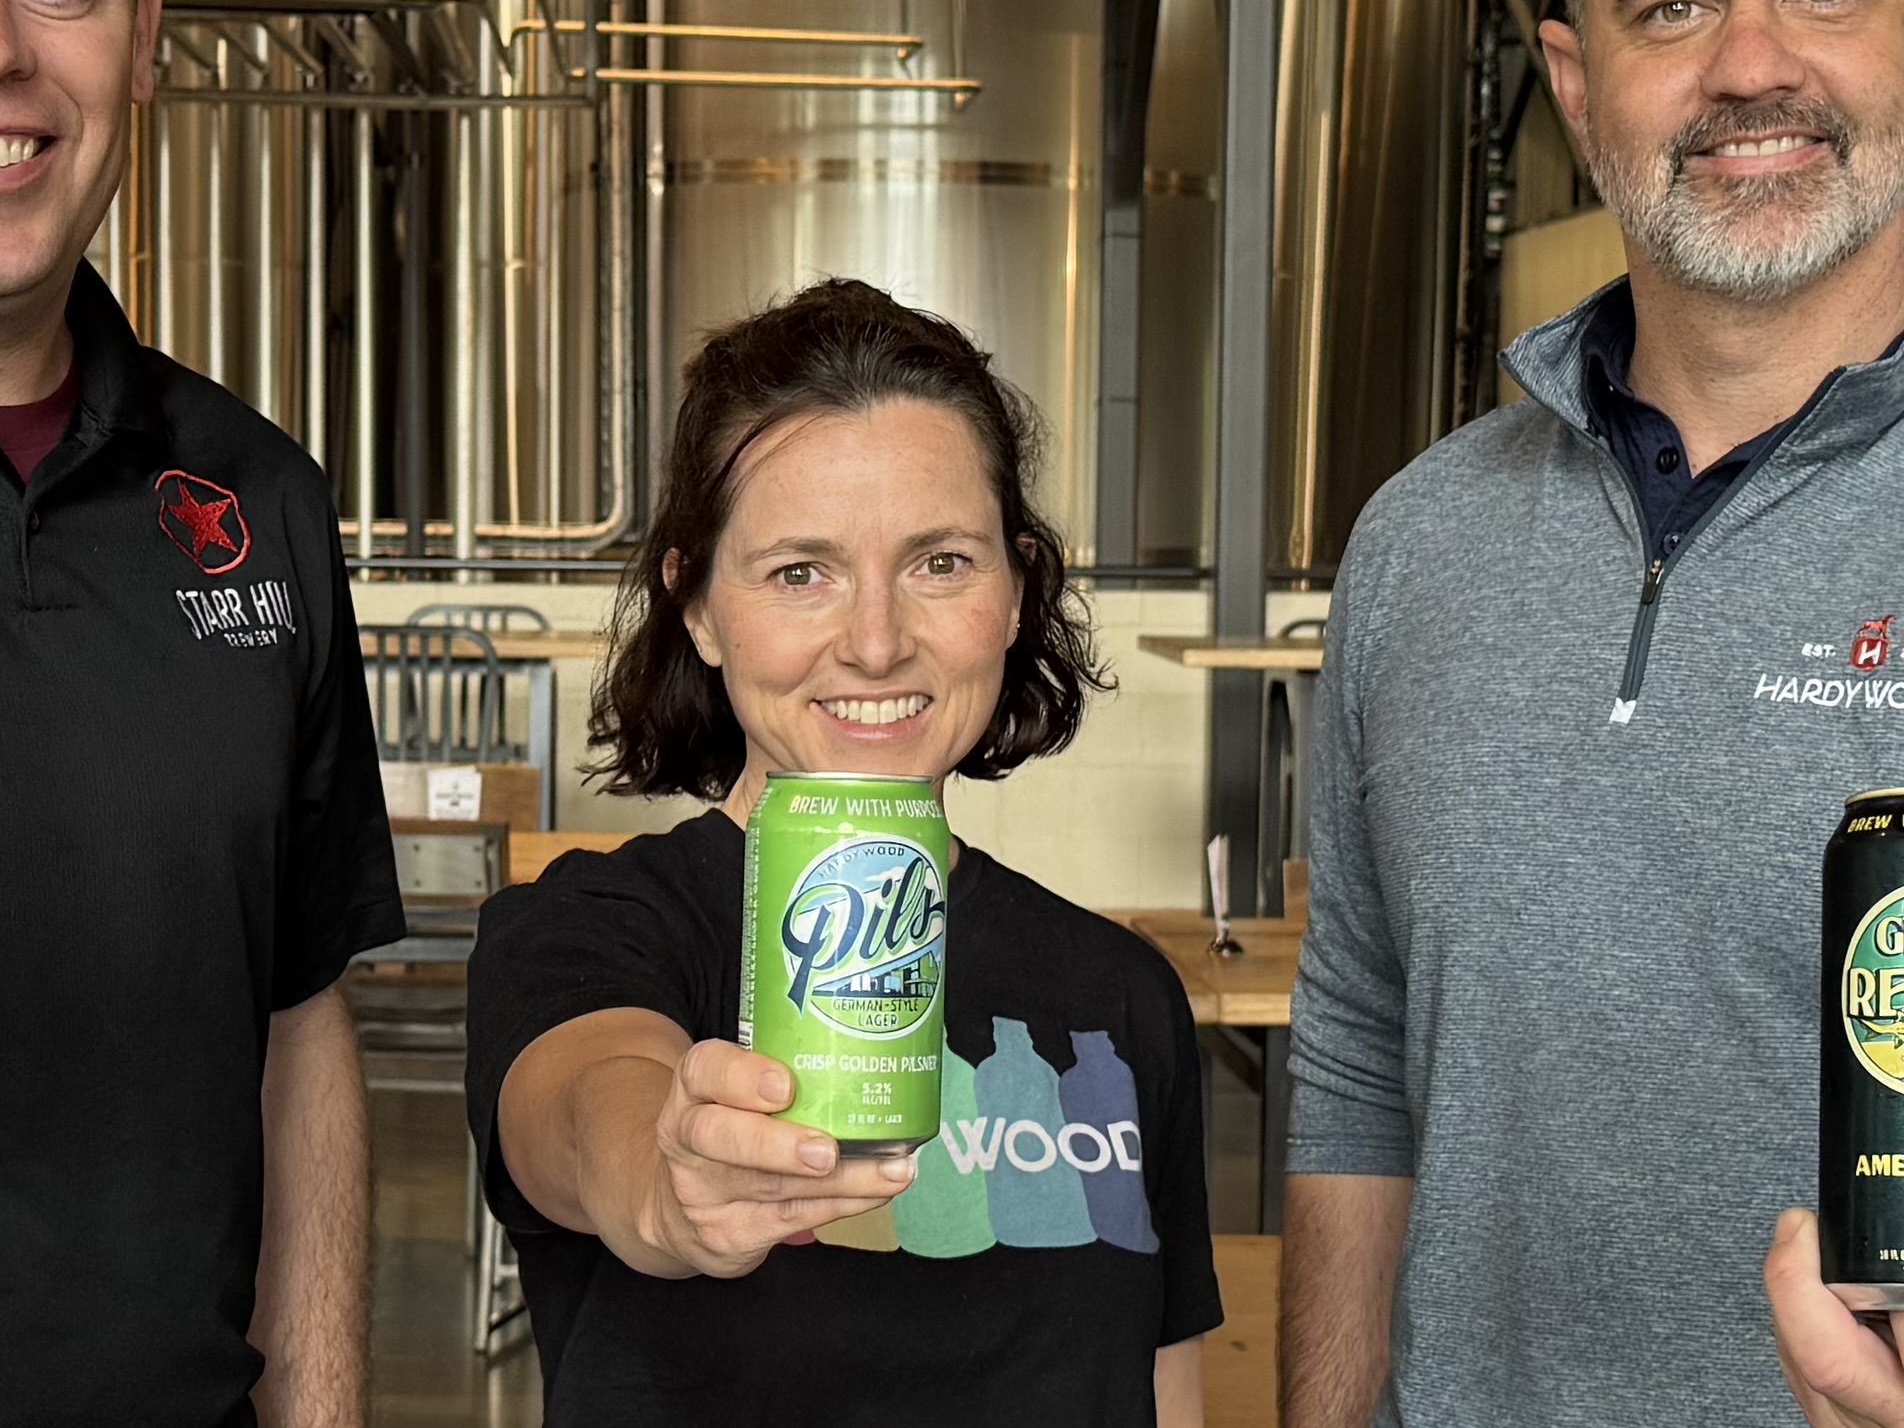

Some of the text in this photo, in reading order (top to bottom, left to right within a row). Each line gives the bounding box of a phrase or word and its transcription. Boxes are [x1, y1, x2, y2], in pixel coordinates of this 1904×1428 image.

[176, 588, 251, 640] STARR
[789, 794, 839, 815] BREW
[846, 797, 891, 817] WITH
[1848, 815, 1893, 833] BREW
[781, 856, 945, 1014] Pils
[833, 999, 919, 1012] GERMAN-STYLE
[858, 1013, 898, 1027] LAGER
[794, 1054, 835, 1070] CRISP
[838, 1054, 897, 1072] GOLDEN
[940, 1116, 1142, 1174] WOOD
